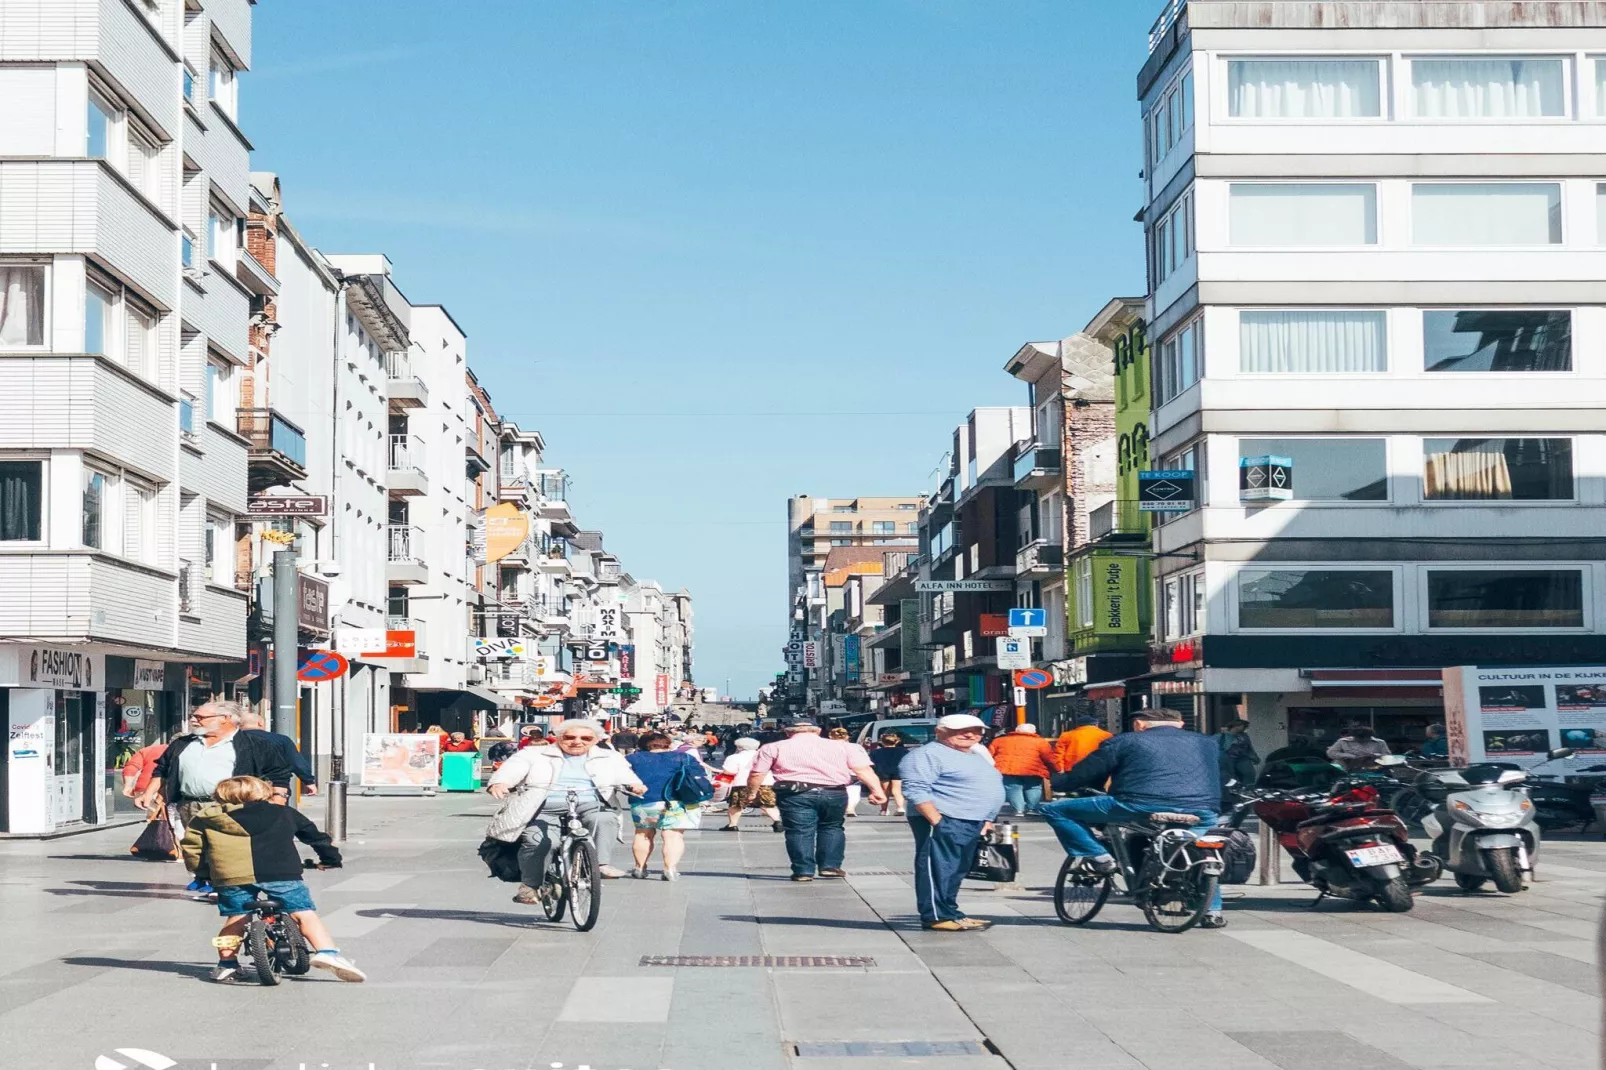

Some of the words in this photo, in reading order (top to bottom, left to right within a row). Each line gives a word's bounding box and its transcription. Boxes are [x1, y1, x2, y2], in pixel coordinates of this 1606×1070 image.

[249, 499, 314, 509] aste
[1106, 563, 1122, 585] Putje
[600, 609, 616, 636] MAXIM
[1107, 595, 1122, 628] Bakkerij
[476, 638, 521, 655] DIVA
[790, 632, 800, 681] HOTEL
[806, 642, 815, 667] BRISTOL
[42, 650, 82, 688] FASHION
